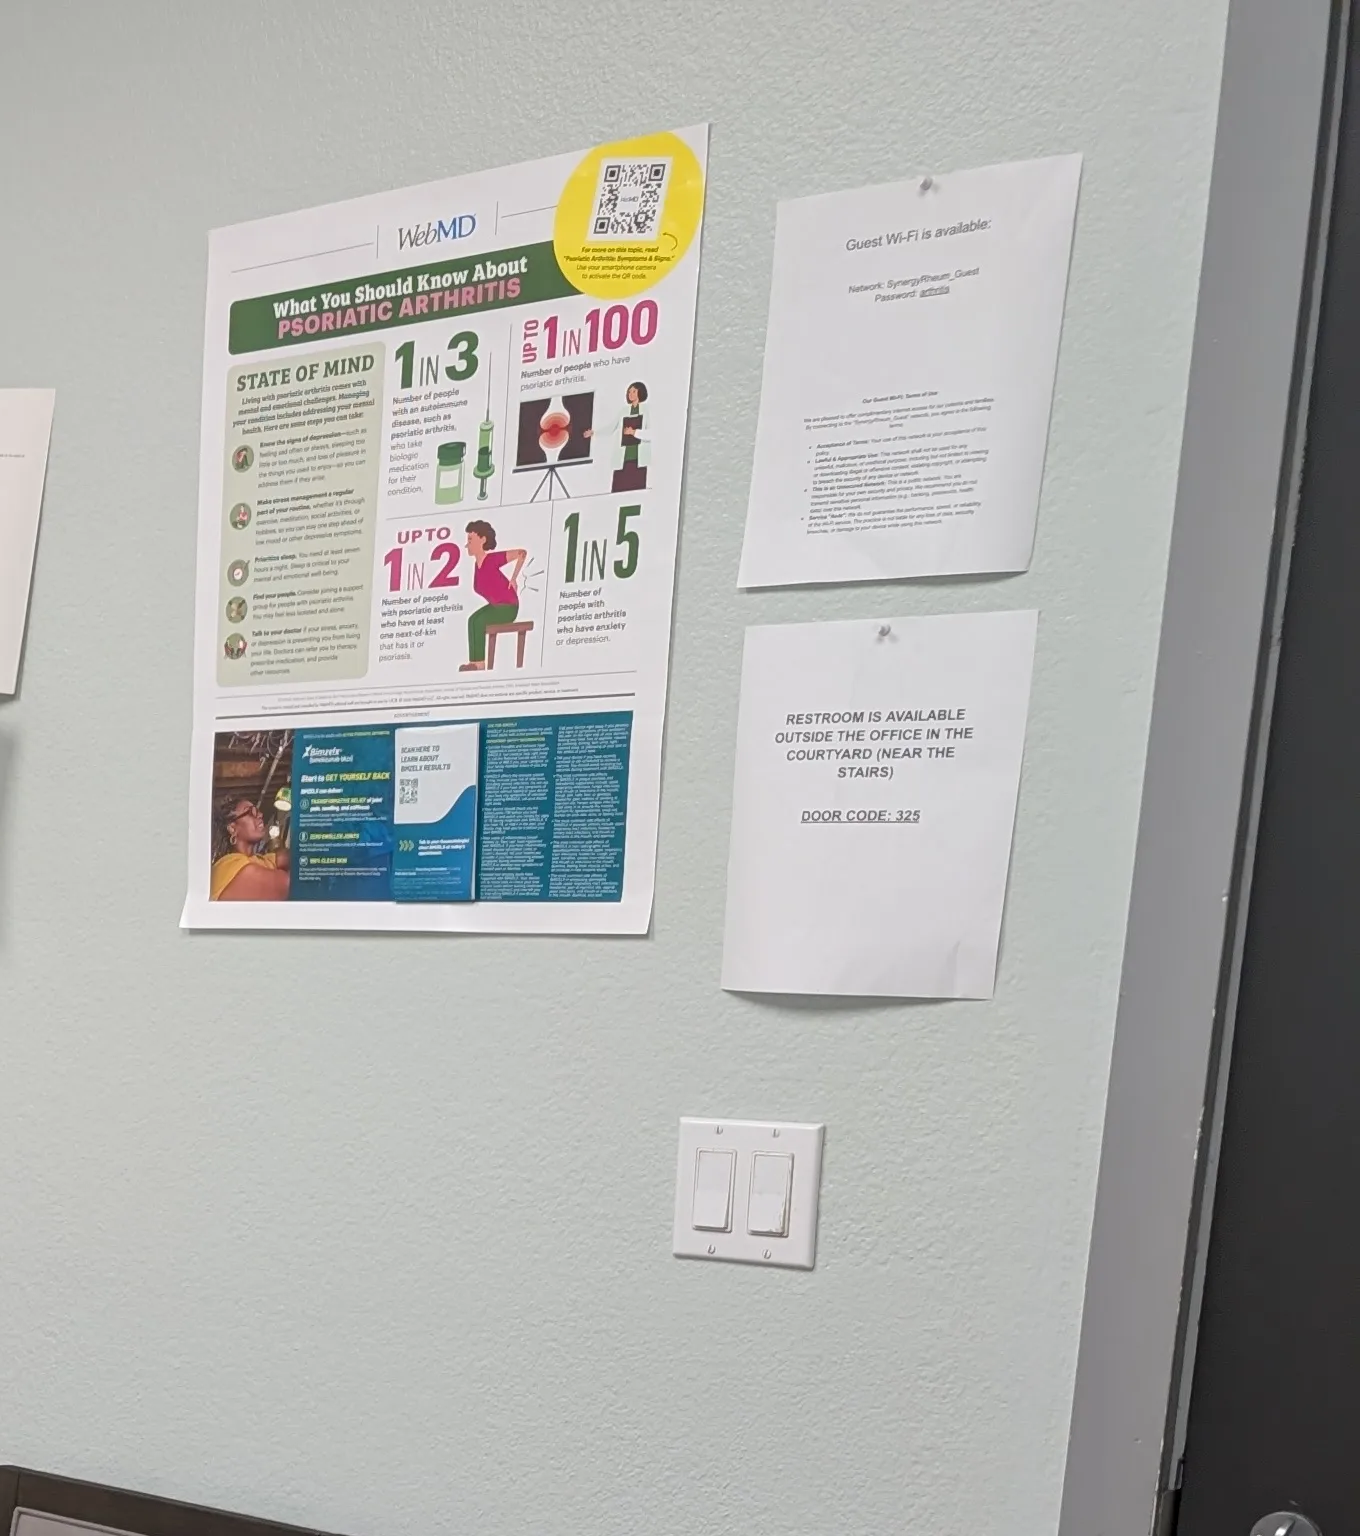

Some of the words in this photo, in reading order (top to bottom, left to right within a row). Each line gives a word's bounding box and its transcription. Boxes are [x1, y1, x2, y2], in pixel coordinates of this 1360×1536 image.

[398, 214, 476, 250] WebMD
[846, 236, 882, 251] Guest
[886, 230, 918, 245] Wi-Fi
[921, 228, 931, 240] is
[935, 219, 991, 238] available:
[273, 300, 317, 319] What
[319, 291, 351, 311] You
[355, 277, 413, 304] Should
[418, 268, 468, 291] Know
[473, 256, 528, 280] About
[848, 282, 885, 293] Network:
[278, 301, 393, 339] PSORIATIC
[399, 278, 521, 318] ARTHRITIS
[524, 320, 539, 341] TO
[544, 316, 558, 359] 1
[562, 328, 581, 357] IN
[585, 300, 658, 352] 100
[522, 343, 537, 363] UP
[394, 340, 415, 390] 1
[420, 355, 439, 386] IN
[445, 331, 479, 381] 3
[521, 366, 552, 378] Number
[554, 364, 562, 374] of
[564, 362, 591, 374] people
[612, 356, 630, 365] have
[237, 368, 291, 391] STATE
[296, 363, 319, 382] OF
[323, 355, 374, 378] MIND
[521, 380, 552, 391] psoriatic
[242, 396, 260, 405] Living
[277, 390, 302, 401] psoriatic
[304, 386, 330, 395] arthritis
[393, 394, 422, 406] Number
[434, 388, 459, 400] people
[238, 407, 258, 416] mental
[273, 401, 302, 410] emotional
[339, 391, 369, 400] Managing
[392, 406, 408, 416] with
[420, 400, 468, 412] autoimmune
[233, 420, 246, 428] your
[248, 415, 275, 425] condition
[277, 411, 301, 420] includes
[303, 406, 335, 417] addressing
[338, 403, 351, 412] your
[353, 400, 374, 408] mental
[392, 417, 422, 428] disease,
[424, 414, 441, 423] such
[307, 418, 322, 427] steps
[391, 428, 423, 440] psoriatic
[390, 451, 418, 462] biologic
[389, 462, 429, 473] medication
[388, 476, 398, 484] for
[400, 474, 416, 483] their
[398, 530, 422, 544] UP
[425, 527, 450, 541] TO
[564, 512, 579, 583] 1
[582, 539, 607, 582] IN
[614, 504, 641, 579] 5
[384, 548, 402, 592] 1
[407, 563, 424, 590] IN
[428, 542, 460, 588] 2
[382, 596, 410, 606] Number
[413, 594, 421, 603] of
[423, 593, 448, 604] people
[560, 590, 590, 599] Number
[592, 588, 602, 597] of
[382, 608, 397, 617] with
[399, 606, 431, 617] psoriatic
[433, 603, 463, 613] arthritis
[559, 602, 588, 612] people
[589, 600, 604, 608] with
[398, 618, 414, 627] have
[427, 616, 444, 624] least
[557, 614, 591, 624] psoriatic
[594, 610, 626, 620] arthritis
[396, 628, 436, 638] next-of-kin
[575, 624, 593, 632] have
[596, 622, 626, 632] anxiety
[379, 642, 393, 650] that
[565, 635, 610, 646] depression.
[379, 653, 412, 663] psoriasis.
[786, 712, 864, 725] RESTROOM
[868, 711, 881, 723] IS
[885, 709, 965, 723] AVAILABLE
[775, 731, 833, 743] OUTSIDE
[838, 730, 866, 742] THE
[870, 729, 922, 741] OFFICE
[926, 729, 940, 740] IN
[945, 727, 973, 739] THE
[786, 748, 872, 761] COURTYARD
[877, 748, 922, 762] (NEAR
[927, 747, 955, 758] THE
[837, 766, 893, 779] STAIRS)
[801, 811, 842, 823] DOOR
[846, 810, 891, 823] CODE:
[896, 810, 920, 823] 325
